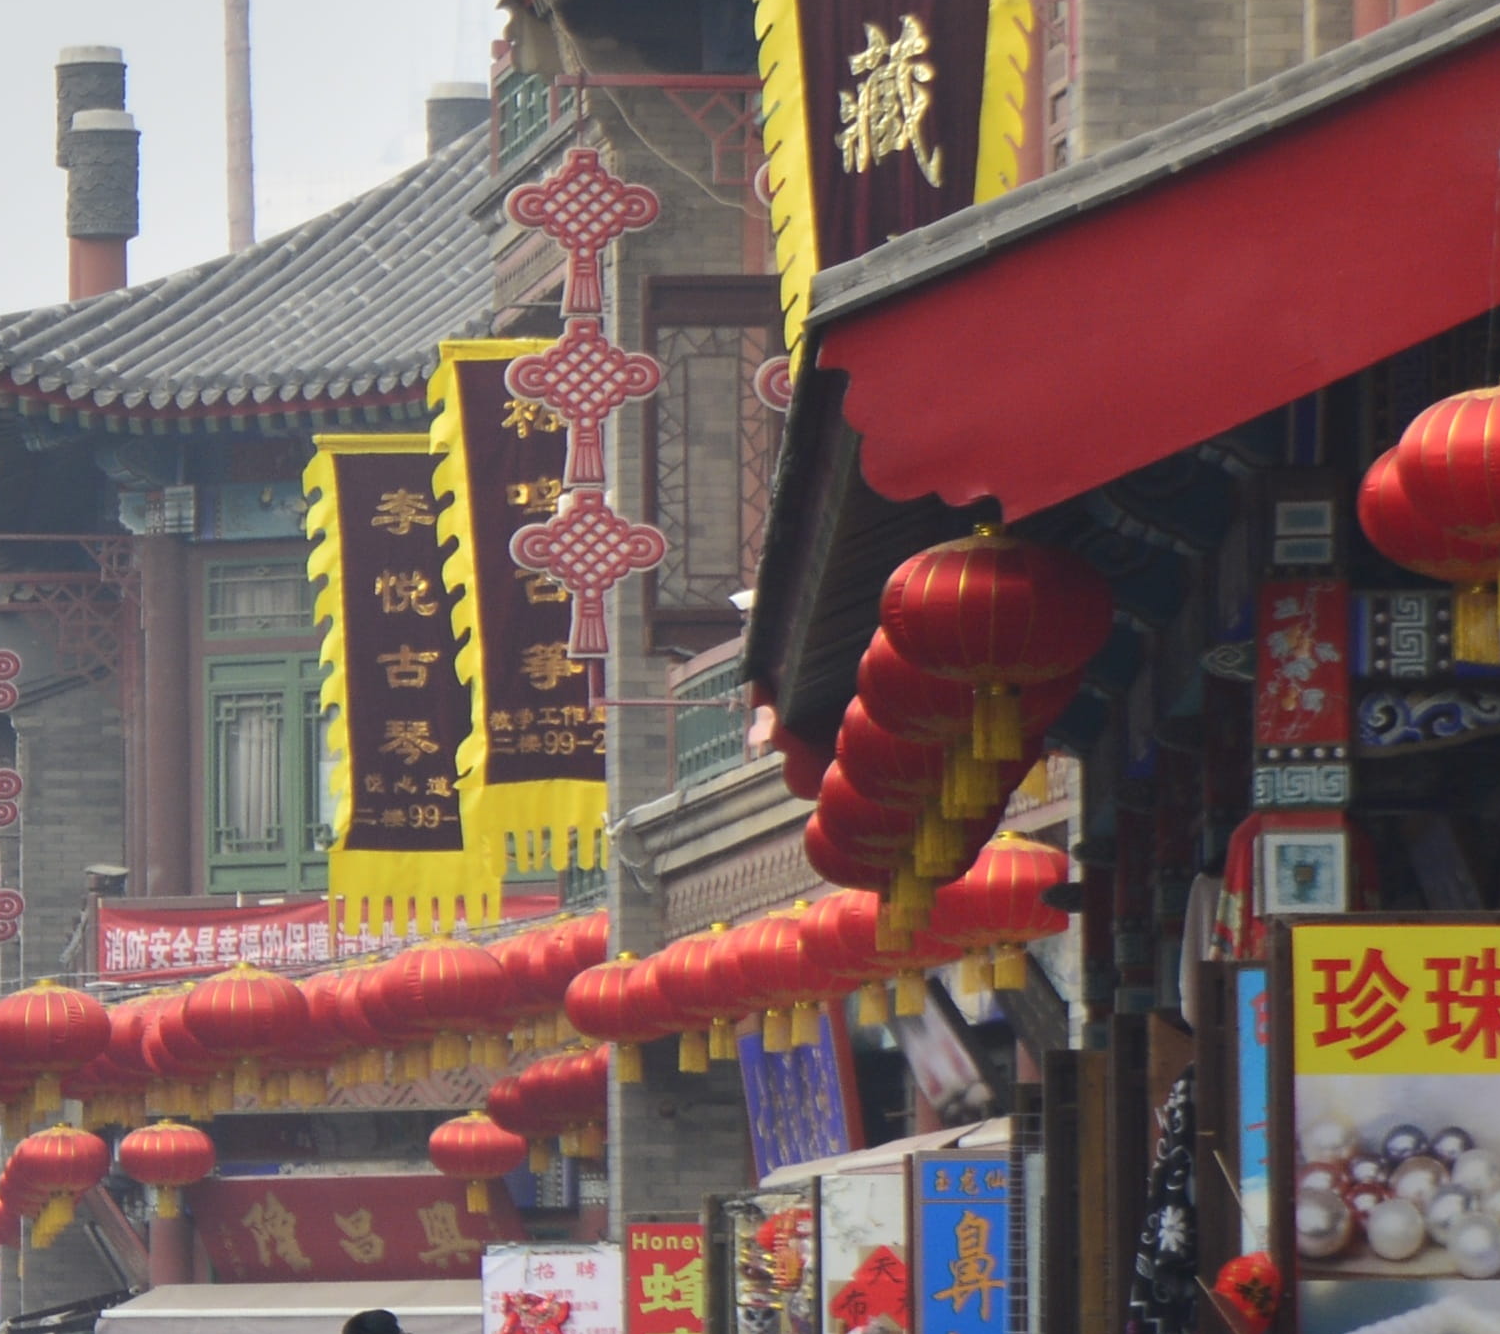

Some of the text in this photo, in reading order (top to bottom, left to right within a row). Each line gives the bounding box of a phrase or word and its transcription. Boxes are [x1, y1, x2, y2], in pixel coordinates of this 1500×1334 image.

[835, 14, 943, 189] 藏
[371, 487, 440, 766] 李悦古琴
[104, 920, 331, 971] 消防安全是幸福的保障
[533, 1259, 598, 1280] 招聘
